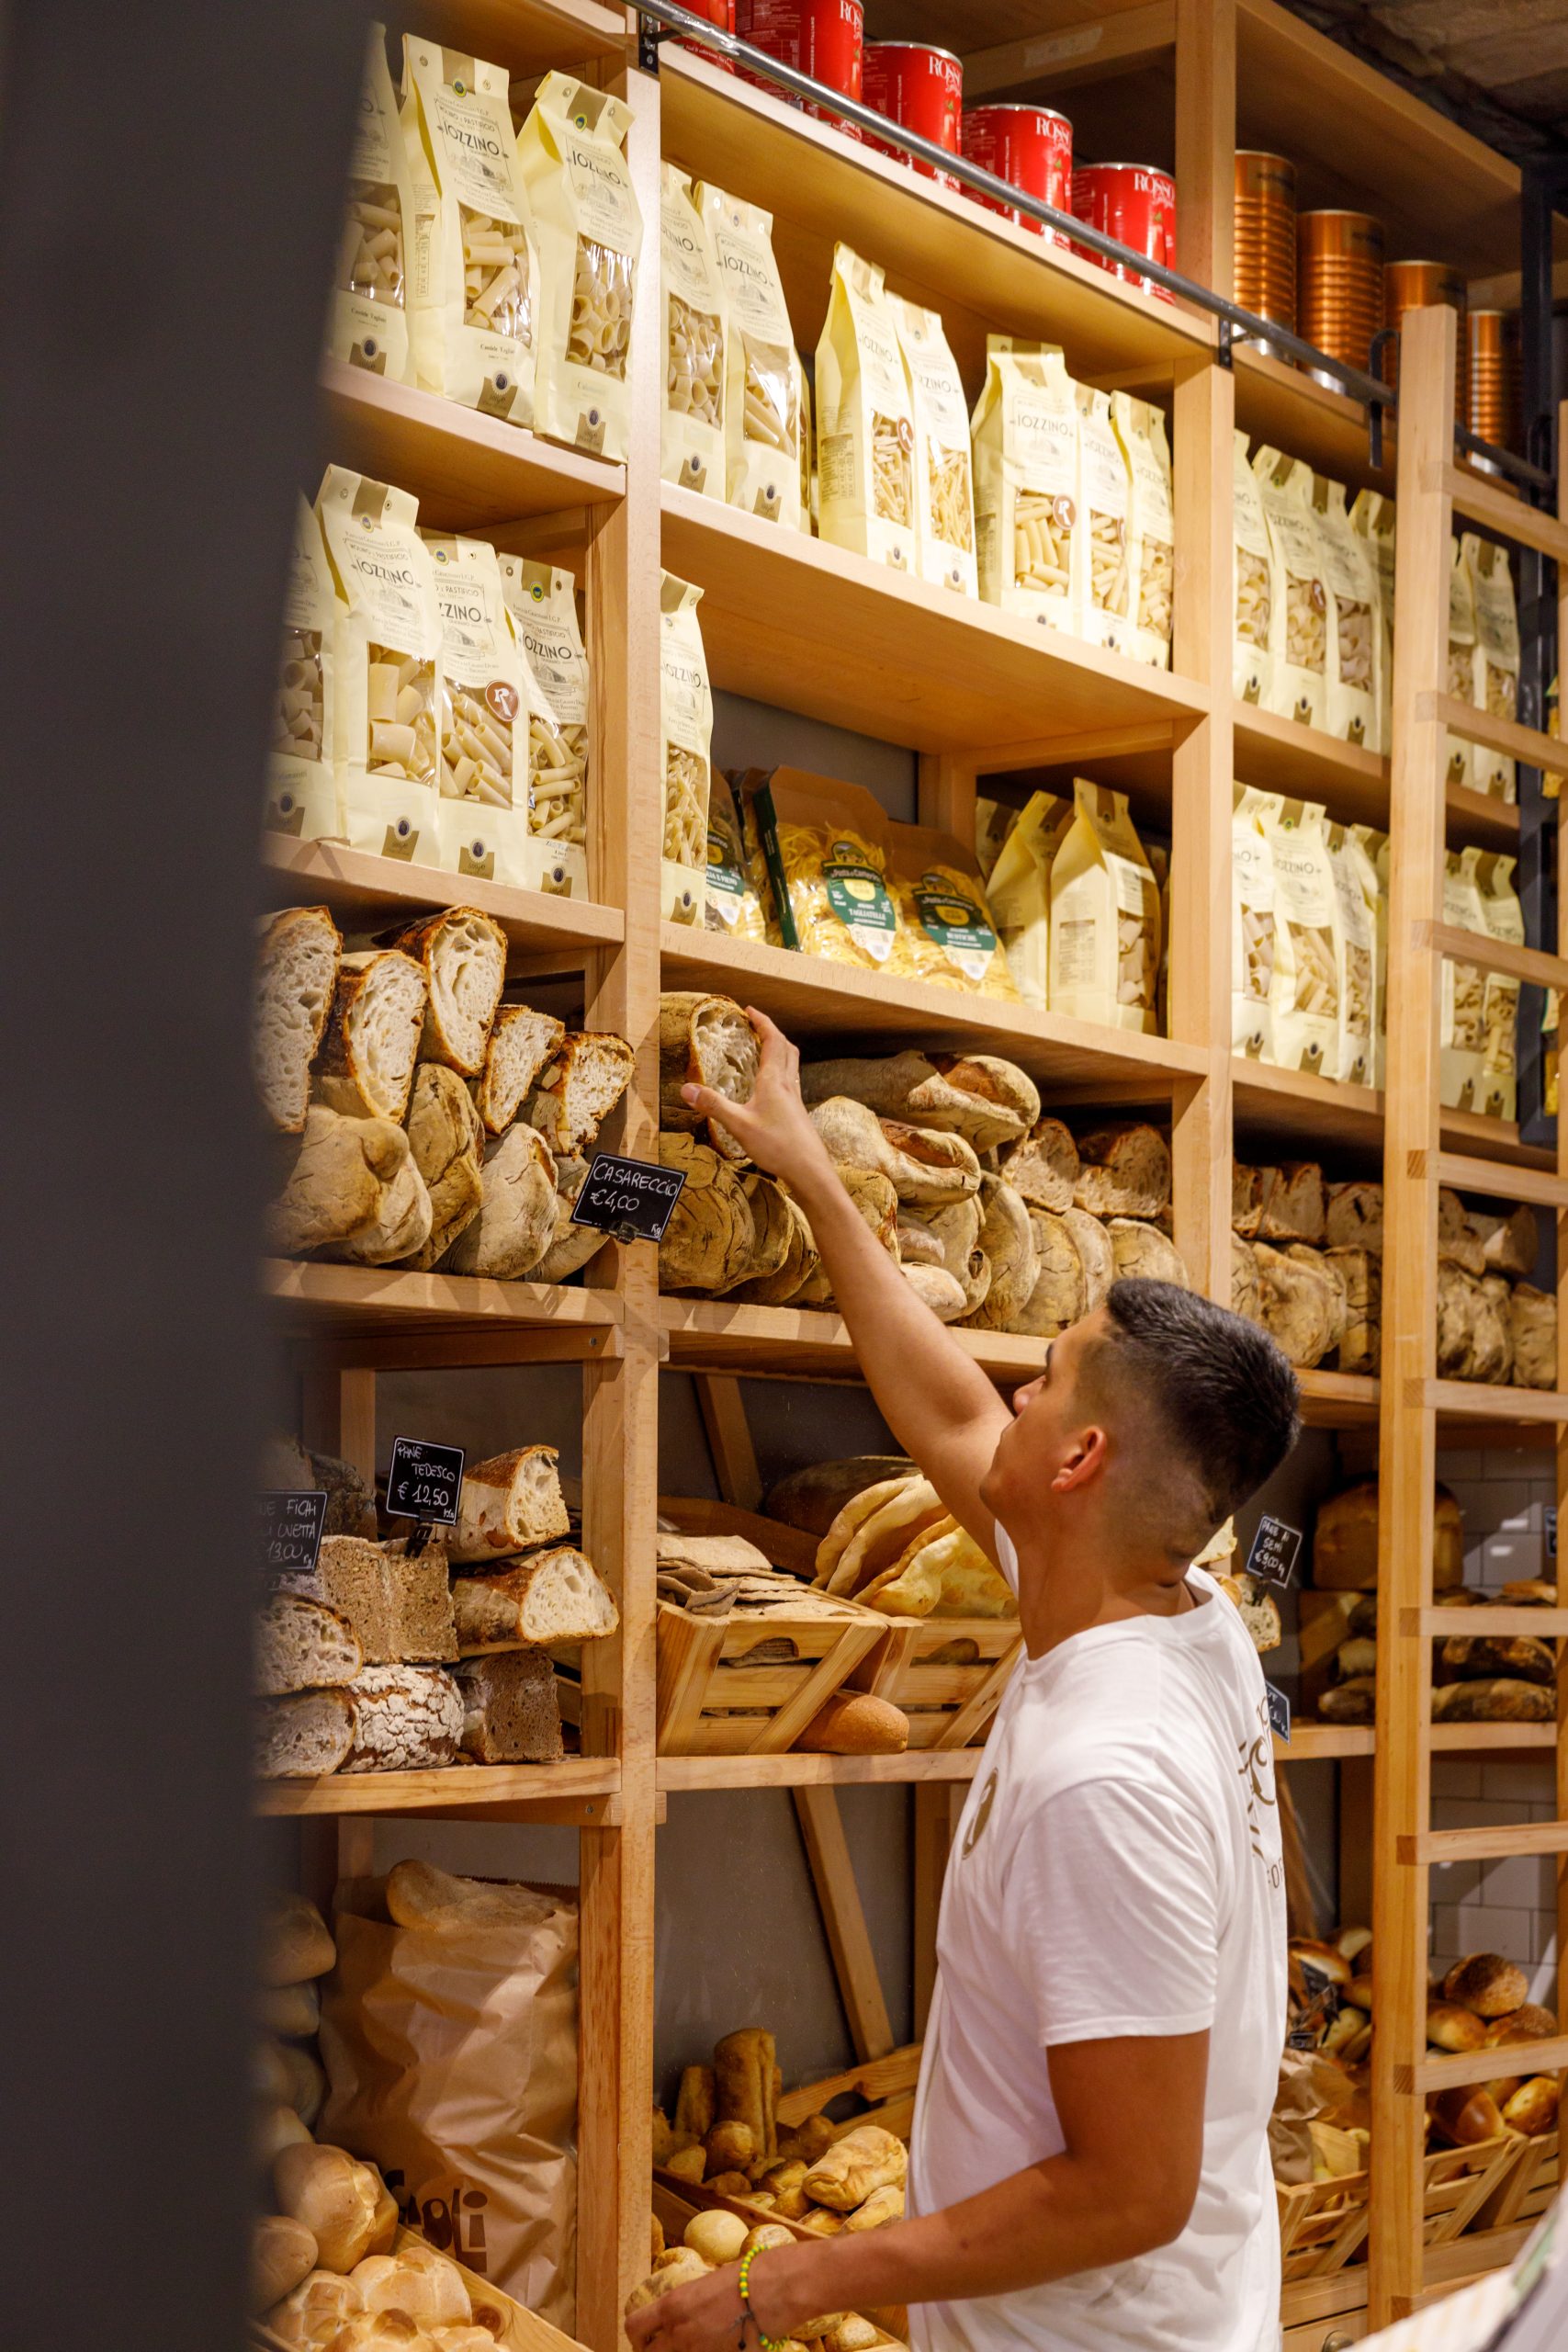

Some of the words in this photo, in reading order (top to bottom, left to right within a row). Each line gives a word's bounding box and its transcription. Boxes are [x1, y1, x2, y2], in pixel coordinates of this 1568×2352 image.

[444, 121, 500, 155] IOZZINO
[1017, 413, 1069, 435] IOZZINO
[355, 559, 414, 585] IOZZINO
[438, 602, 481, 623] ZINO
[590, 1188, 640, 1214] €4,00
[397, 1441, 423, 1460] PANE
[411, 1462, 456, 1482] TEDESCO
[397, 1480, 410, 1500] €
[412, 1484, 449, 1506] 12,50
